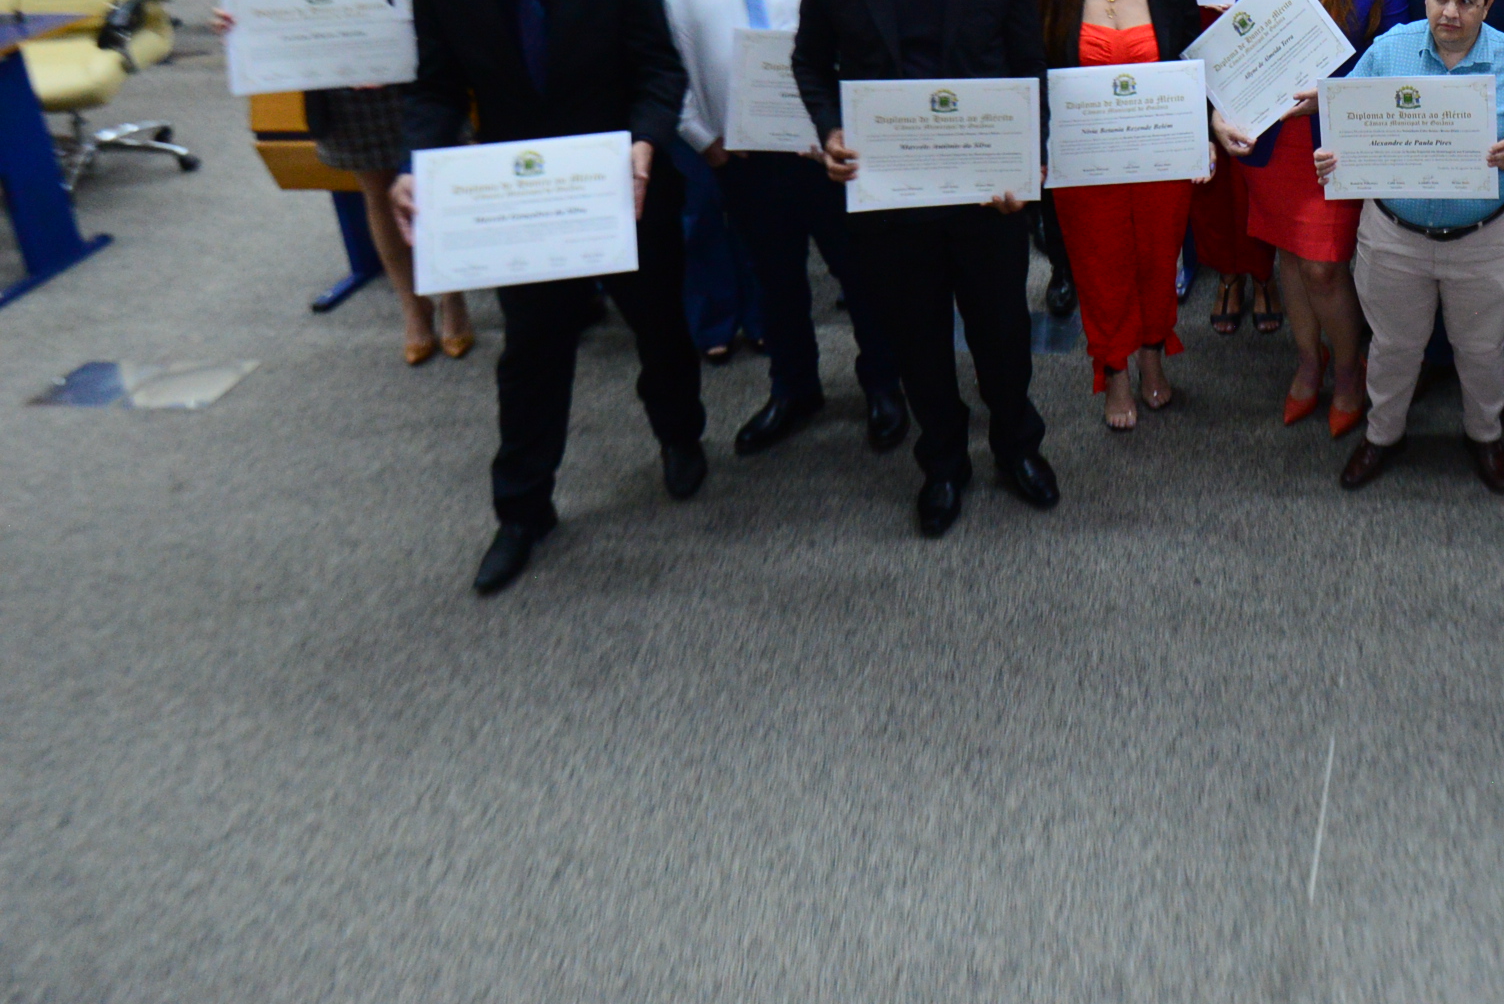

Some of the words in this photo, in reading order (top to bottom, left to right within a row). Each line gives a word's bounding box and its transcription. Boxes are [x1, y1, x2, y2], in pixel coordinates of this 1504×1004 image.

[1213, 49, 1238, 72] Diploma
[1245, 25, 1264, 44] Honra
[1265, 19, 1272, 28] ao
[1272, 0, 1293, 21] Mérito
[1265, 45, 1281, 62] Almeida
[1281, 35, 1294, 47] Terra
[1065, 101, 1101, 110] Diploma
[1157, 95, 1185, 104] Mérito
[1347, 112, 1383, 120] Diploma
[1399, 111, 1423, 120] Honra
[1442, 111, 1472, 120] Mérito
